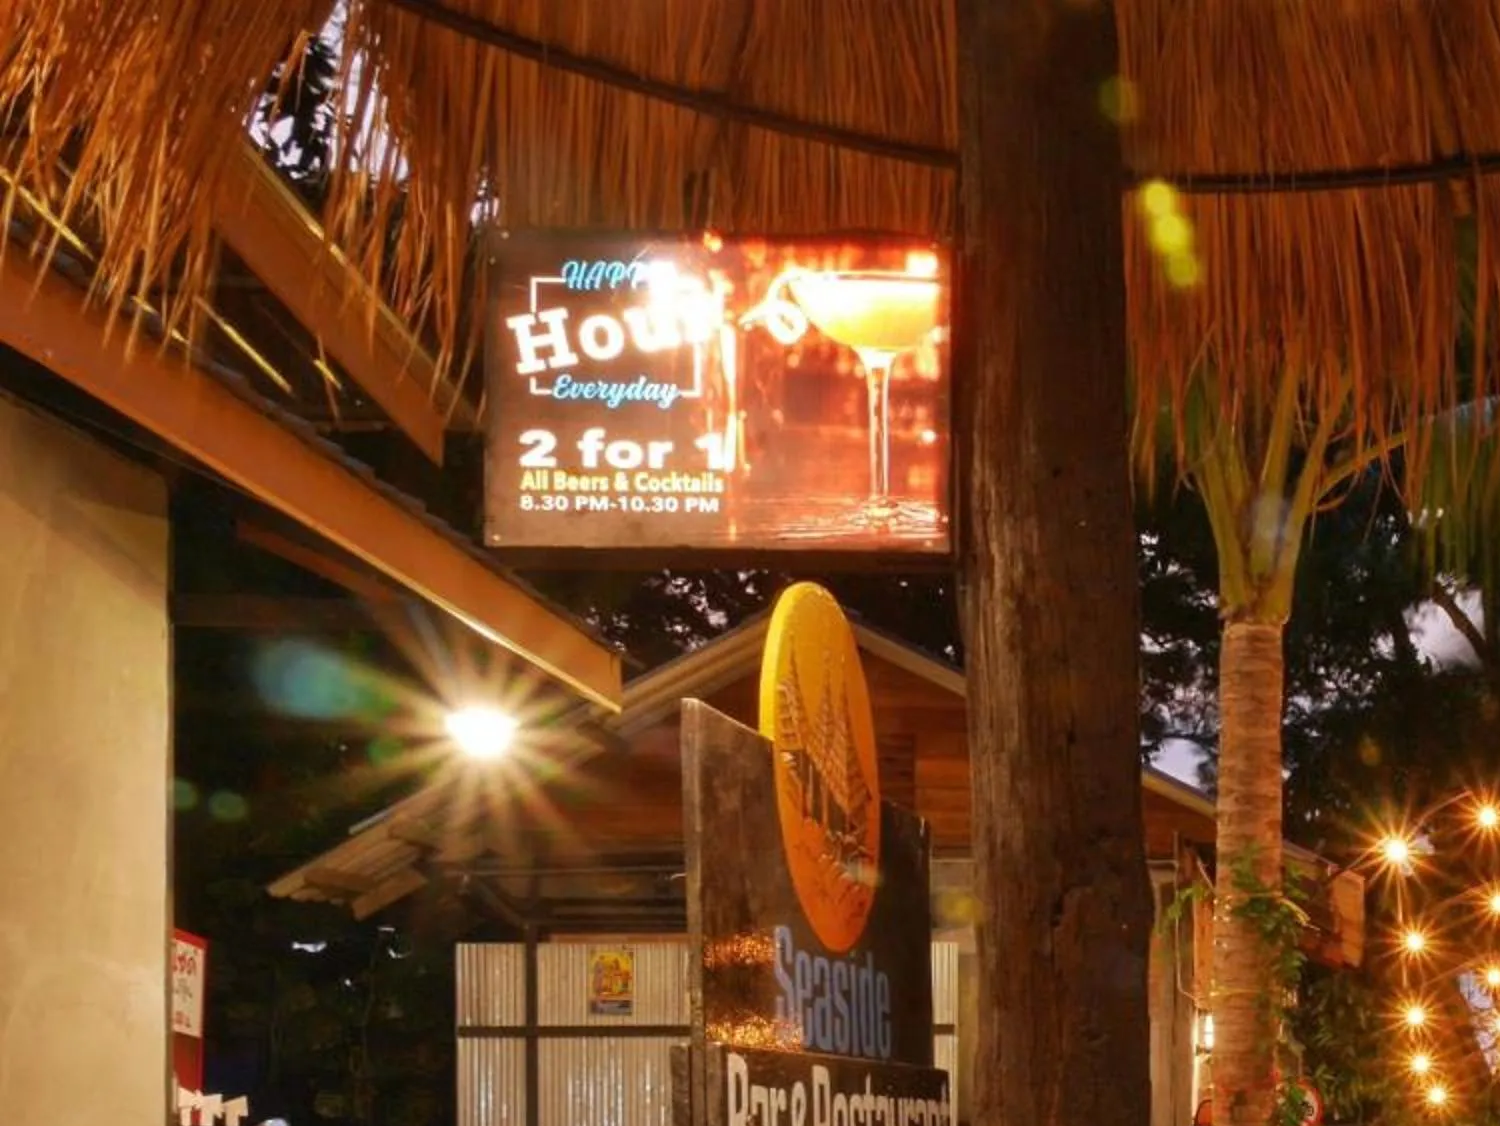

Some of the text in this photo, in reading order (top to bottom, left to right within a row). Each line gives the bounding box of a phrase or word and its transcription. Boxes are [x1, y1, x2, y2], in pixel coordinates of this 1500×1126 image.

[561, 260, 667, 290] HAPP
[553, 373, 679, 408] Everyday
[518, 428, 557, 468] 2
[577, 427, 674, 469] for
[520, 469, 723, 493] All Beers & Cocktails
[774, 925, 892, 1059] Seaside
